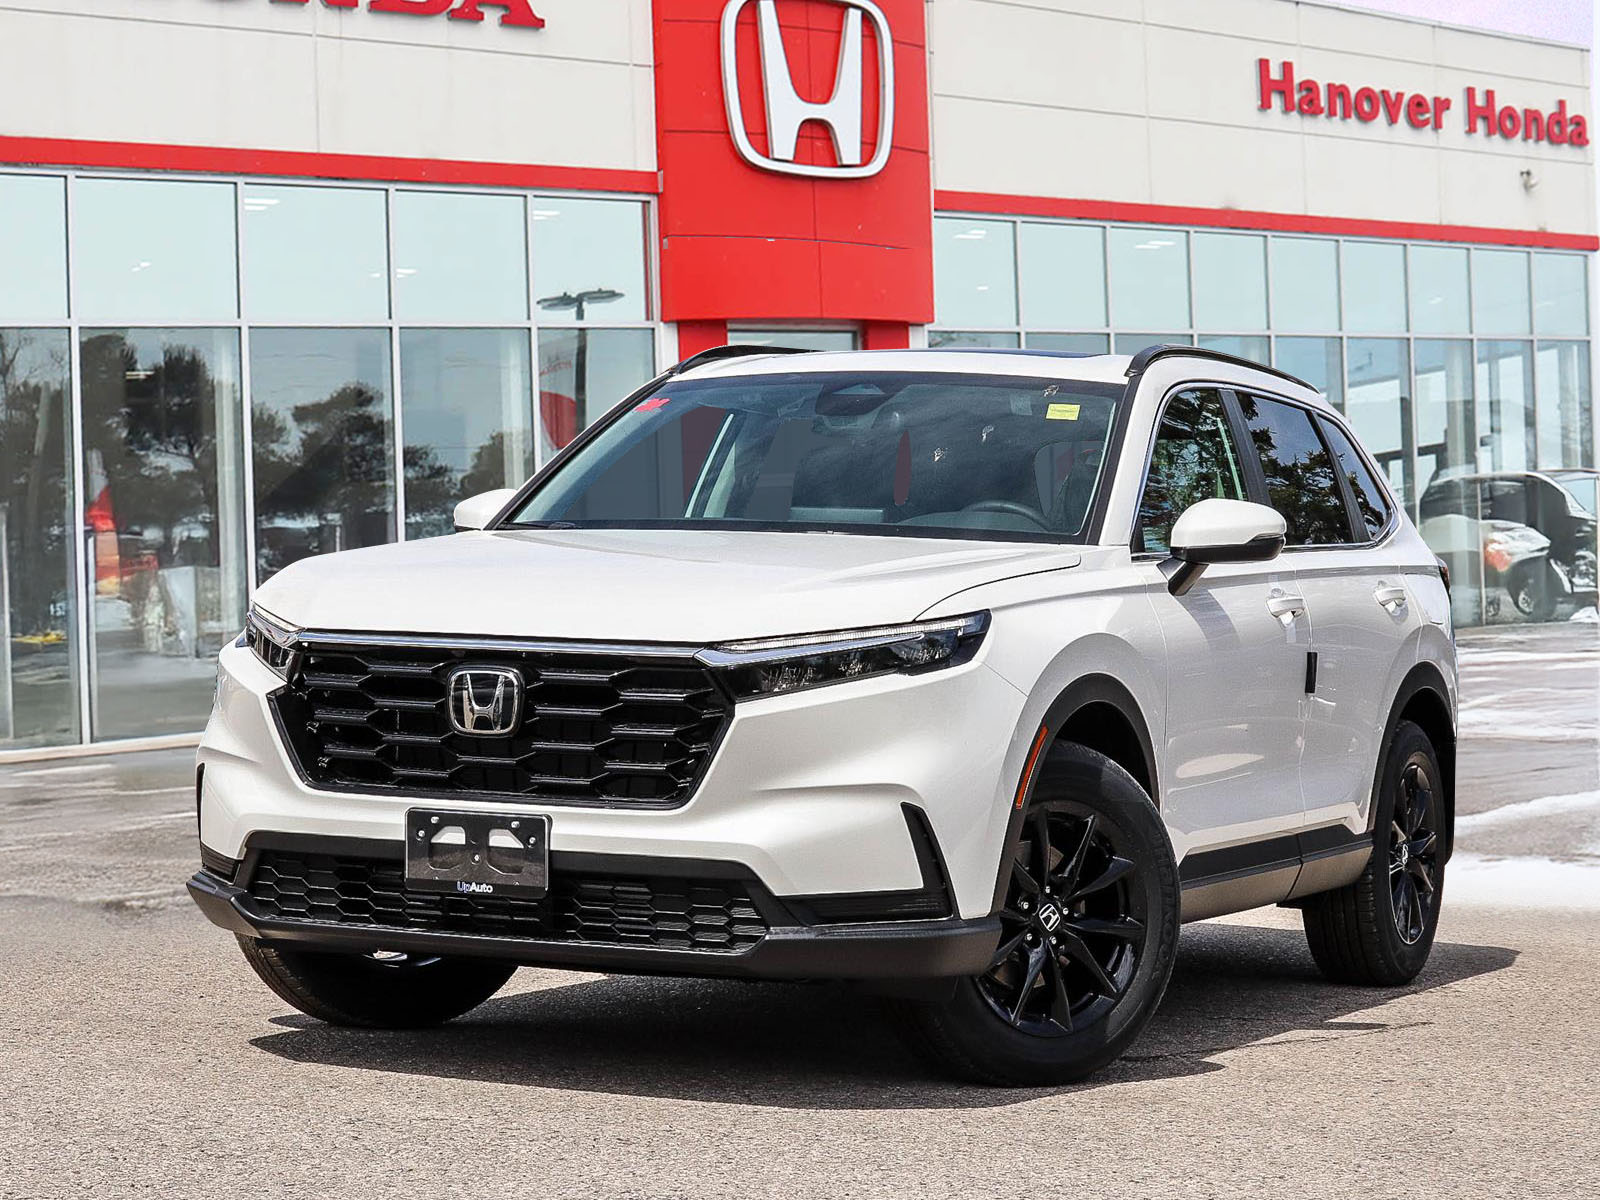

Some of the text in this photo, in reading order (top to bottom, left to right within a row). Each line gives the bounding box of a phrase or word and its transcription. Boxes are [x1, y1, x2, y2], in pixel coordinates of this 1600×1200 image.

[1257, 57, 1590, 147] Hanover Honda
[456, 880, 494, 894] UpAuto
